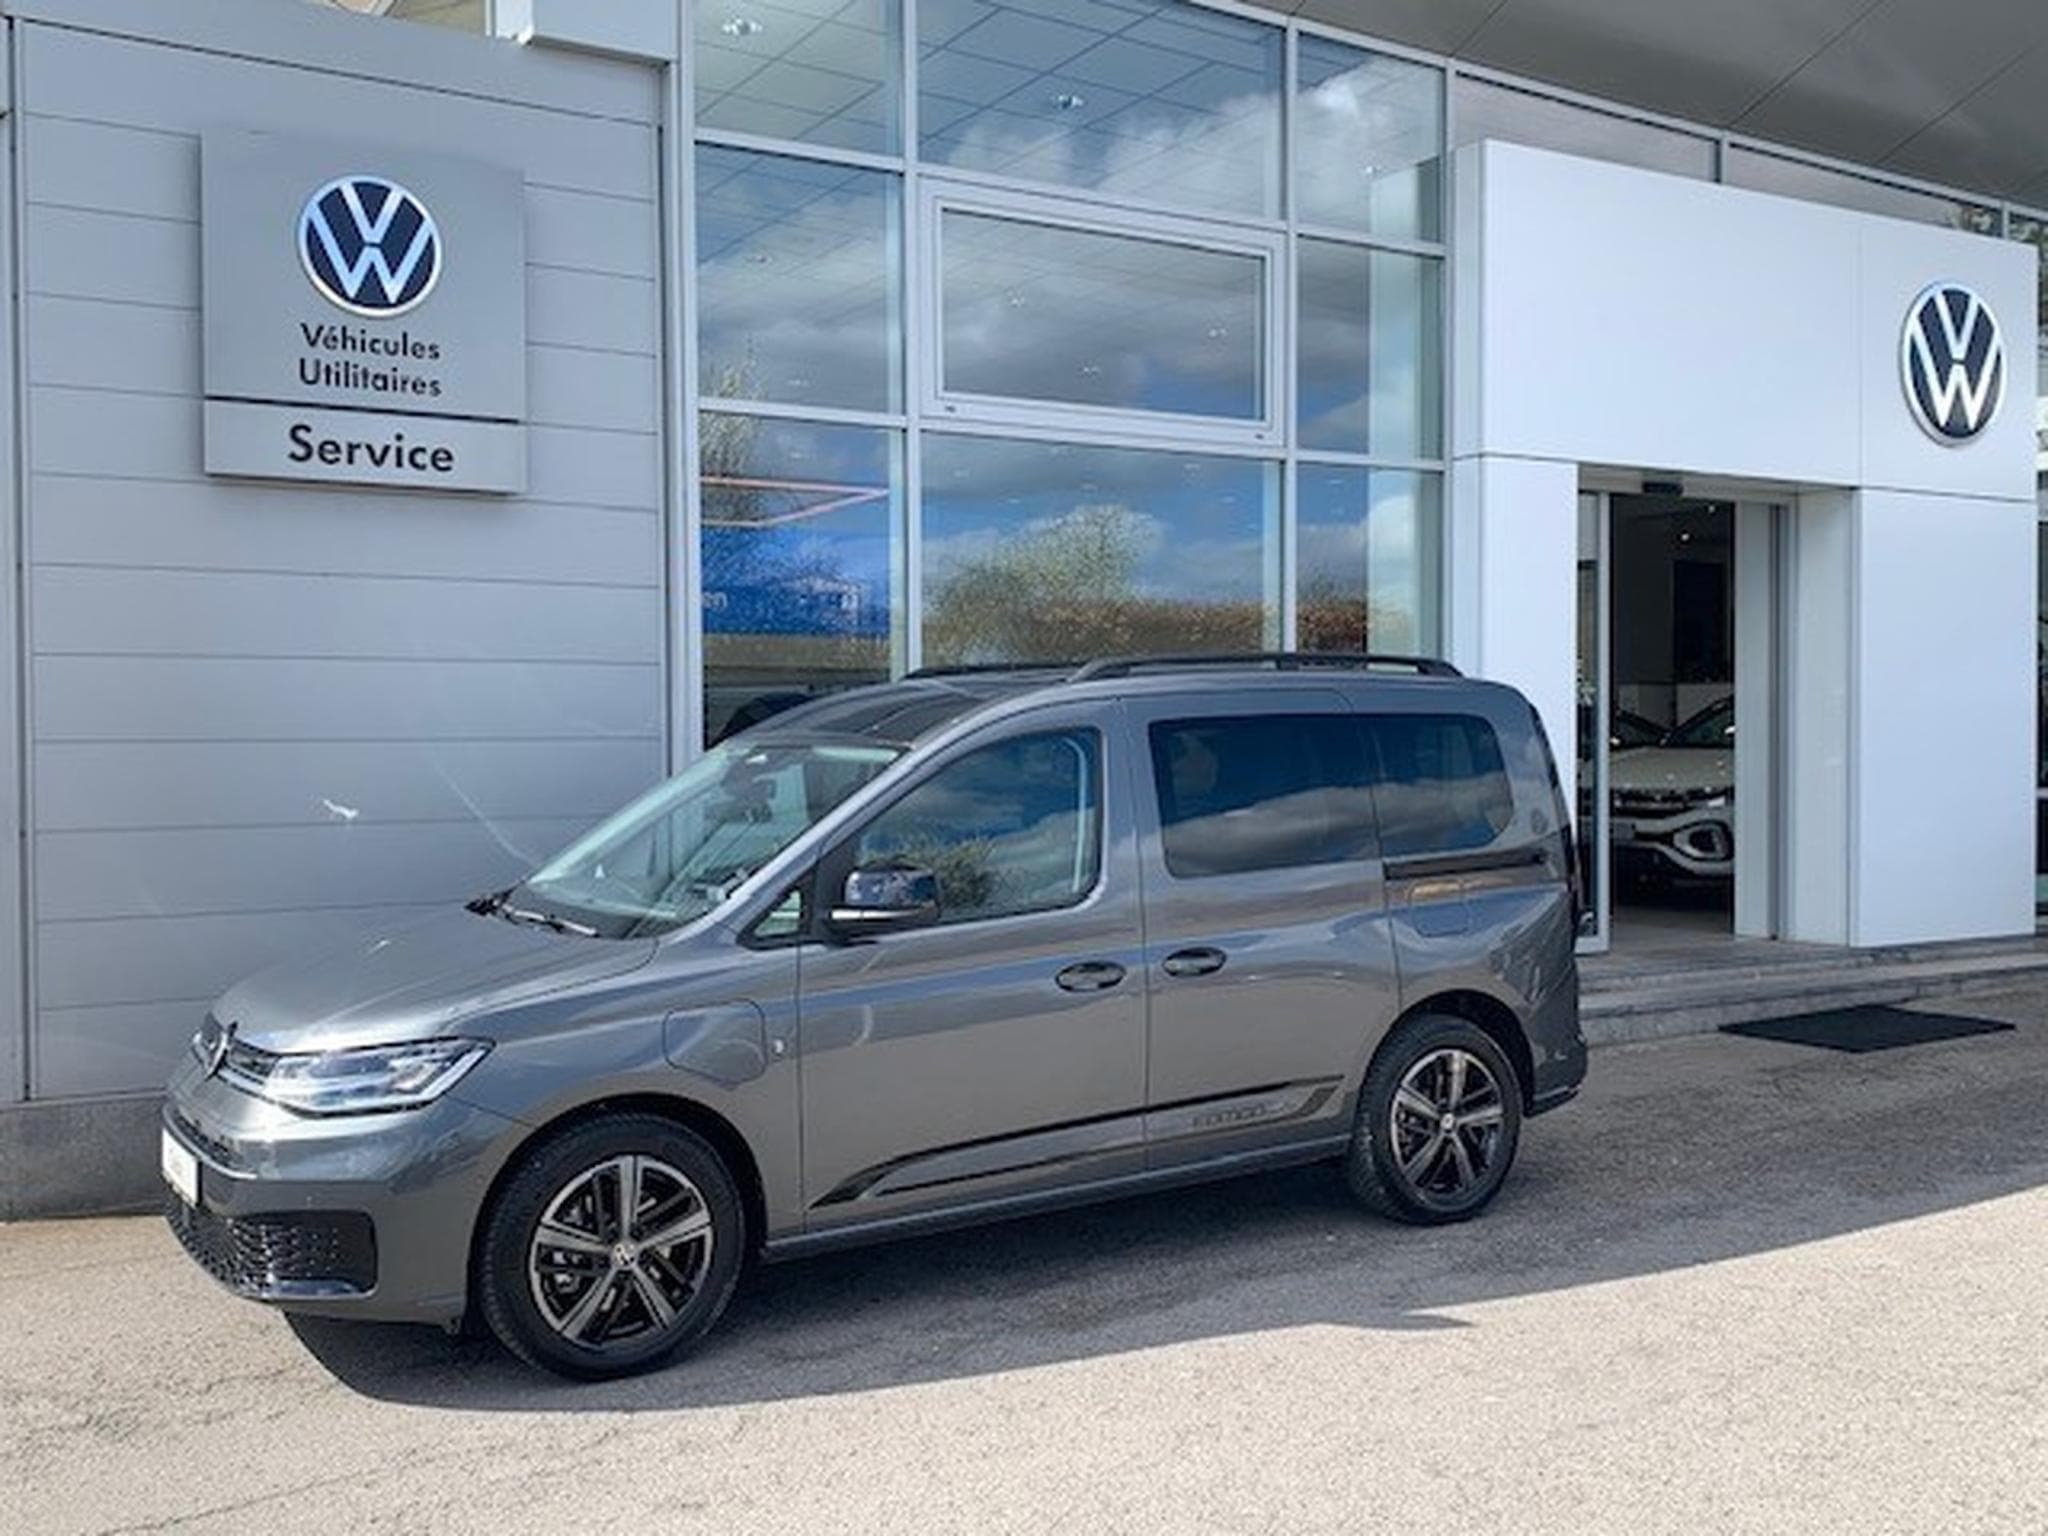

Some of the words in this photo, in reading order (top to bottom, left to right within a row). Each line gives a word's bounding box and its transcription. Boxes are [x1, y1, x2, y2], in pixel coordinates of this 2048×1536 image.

[303, 179, 436, 305] VW
[300, 322, 441, 360] Véhicules
[1910, 286, 2002, 432] VW
[299, 358, 442, 398] Utilitaires
[288, 423, 454, 472] Service
